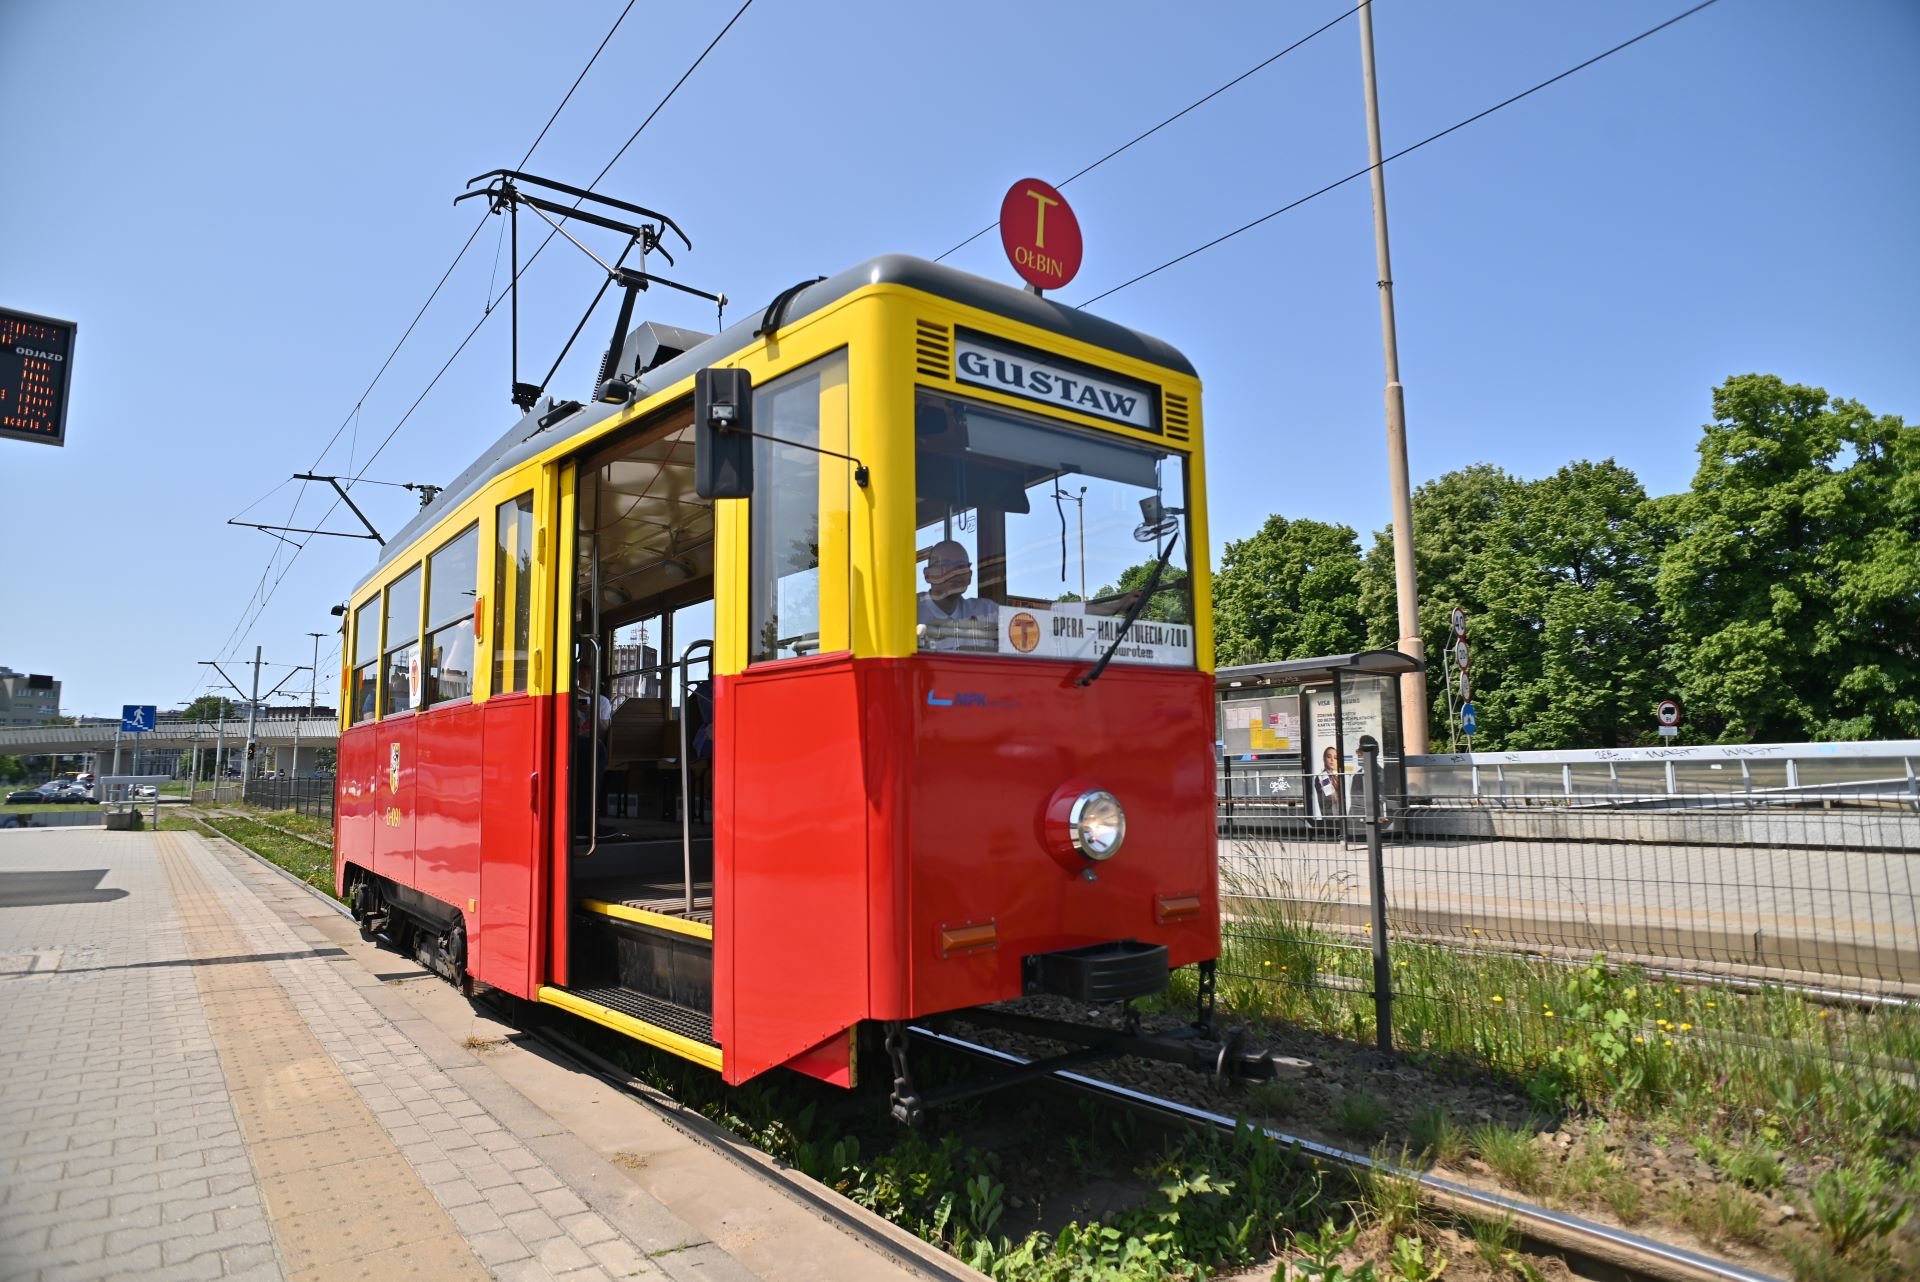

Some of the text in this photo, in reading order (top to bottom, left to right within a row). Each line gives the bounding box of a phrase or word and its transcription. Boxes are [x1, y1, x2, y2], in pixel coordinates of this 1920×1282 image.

[1027, 189, 1059, 249] T
[1015, 246, 1063, 279] OŁBIN
[15, 347, 63, 362] ODJAZD
[958, 351, 1137, 417] GUSTAW
[1053, 616, 1084, 639] OPERA
